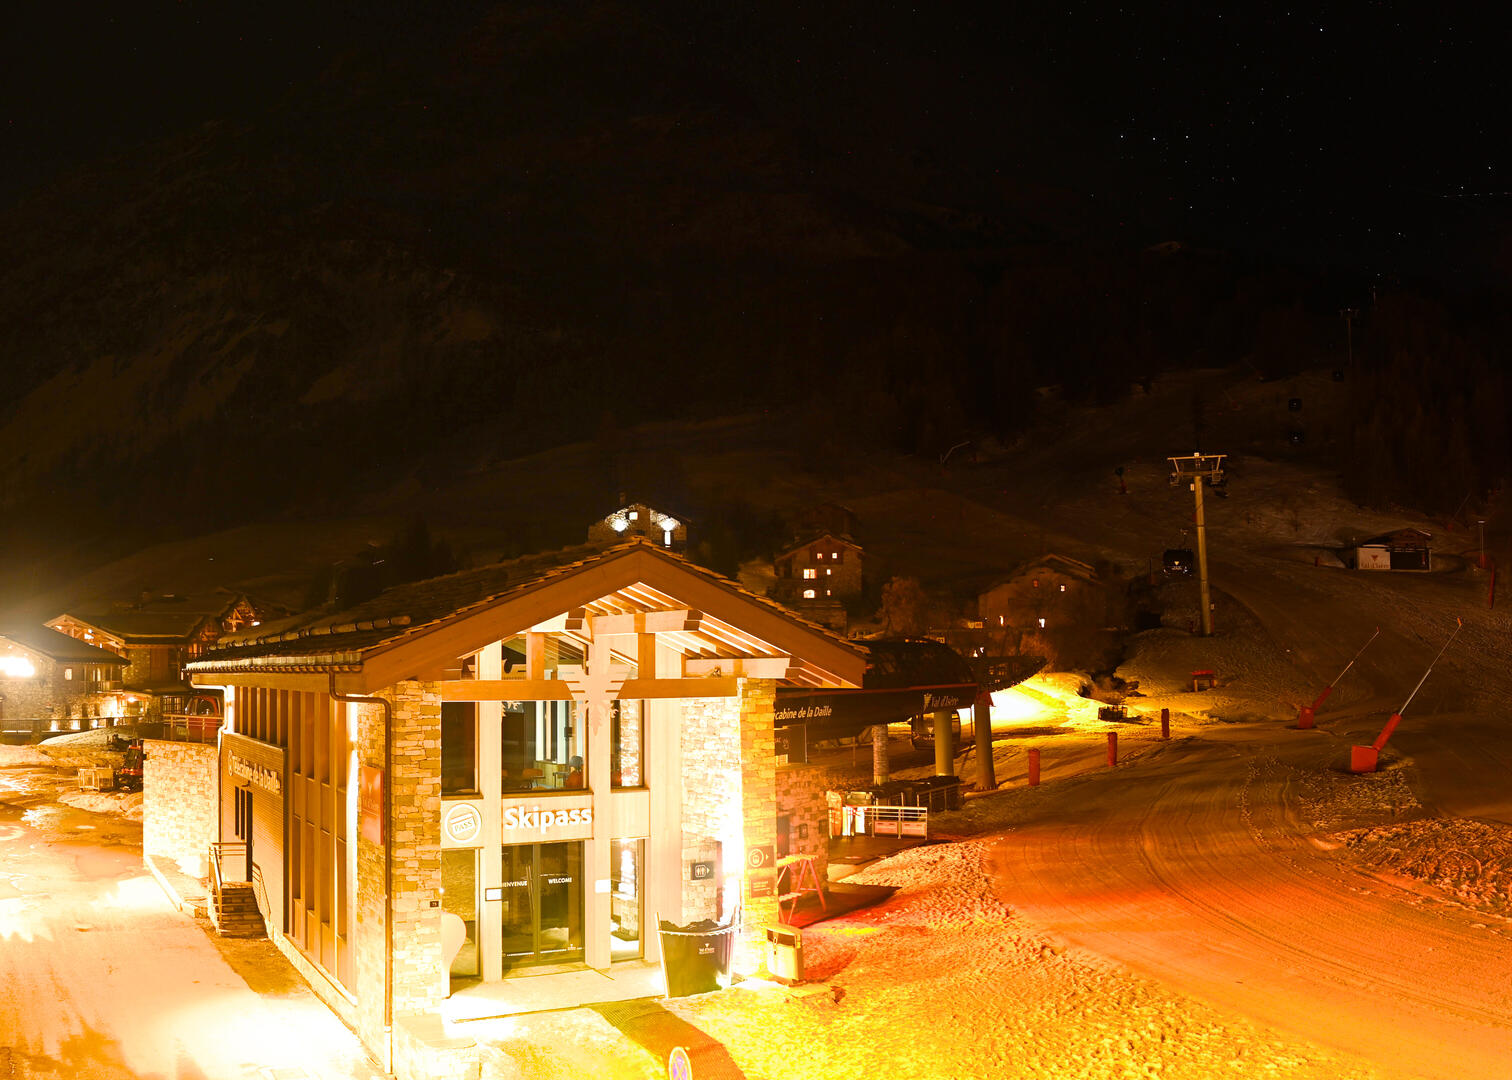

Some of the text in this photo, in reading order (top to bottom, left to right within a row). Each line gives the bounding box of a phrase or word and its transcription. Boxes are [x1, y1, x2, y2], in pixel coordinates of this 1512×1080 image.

[798, 707, 806, 718] de
[807, 706, 813, 718] la
[814, 705, 832, 717] Daille
[455, 819, 473, 832] PASS
[504, 806, 592, 834] Skipass
